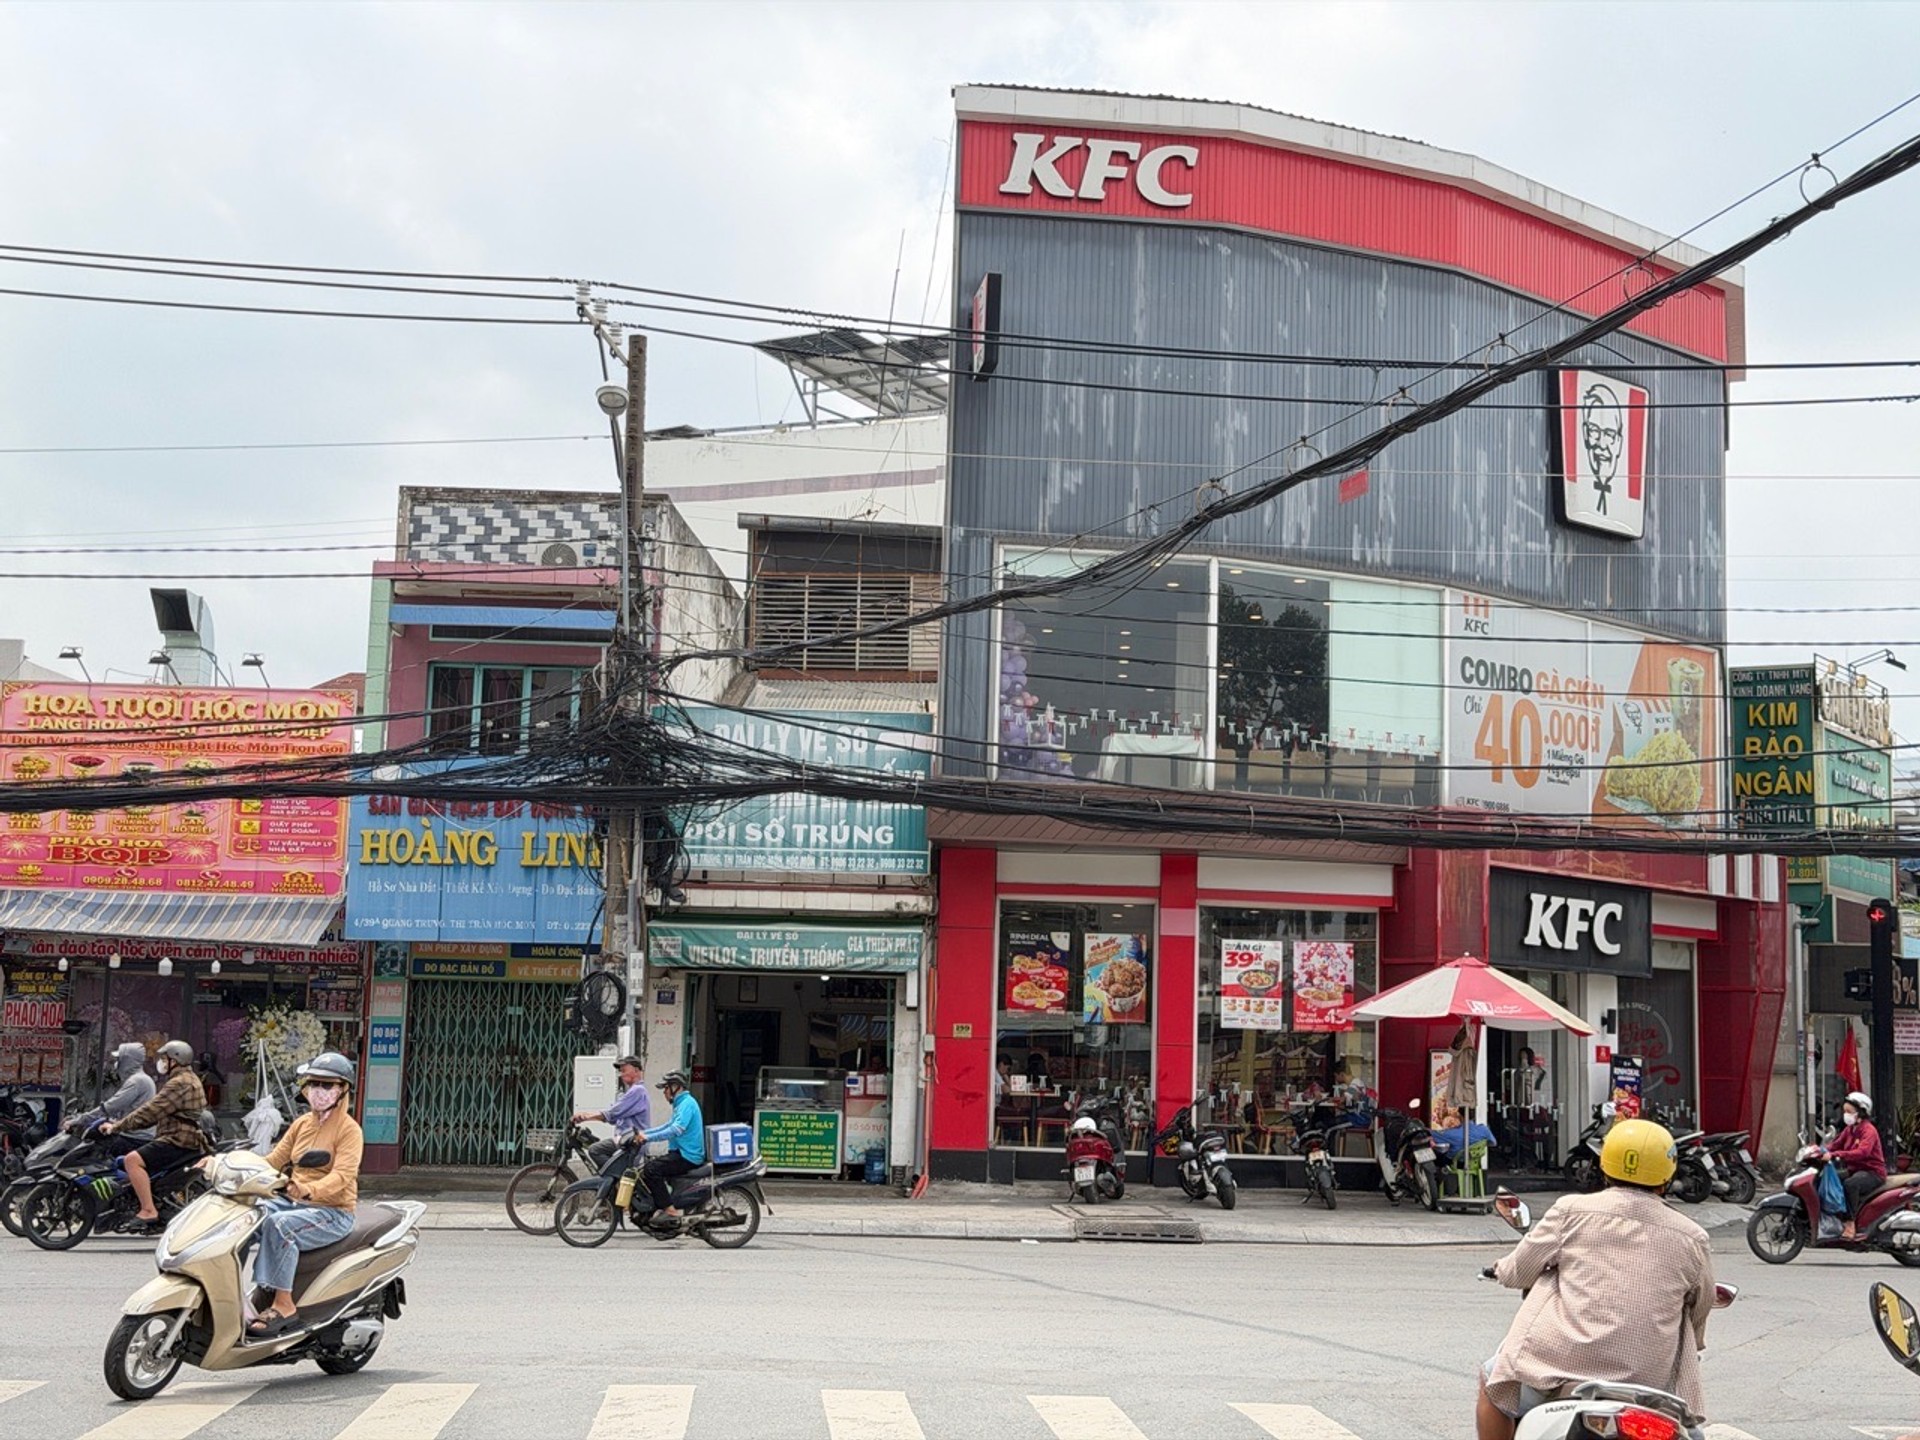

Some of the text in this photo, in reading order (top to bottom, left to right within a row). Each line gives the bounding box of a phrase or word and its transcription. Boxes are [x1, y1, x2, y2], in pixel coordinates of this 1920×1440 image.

[999, 133, 1199, 207] KFC
[1464, 618, 1489, 635] KFC
[1460, 655, 1533, 695] COMBO
[1536, 668, 1562, 701] GÀ
[1732, 669, 1809, 682] CÔNG TY TNHH MTV
[1732, 682, 1811, 697] KINH DOANH VÀNG
[263, 699, 341, 721] MÔN
[1748, 701, 1798, 727] KIM
[836, 719, 870, 753] SỐ
[1744, 730, 1805, 760] BẢO
[1734, 765, 1813, 797] NGÂN
[1466, 798, 1480, 807] KFC
[1776, 805, 1812, 823] ITALY
[50, 836, 166, 848] PHÁO HOA
[360, 817, 499, 866] HOÀNG
[745, 816, 786, 842] SỐ
[792, 818, 894, 845] TRÚNG
[47, 845, 172, 866] BQP
[1524, 893, 1622, 955] KFC
[847, 936, 864, 952] GIA
[895, 933, 919, 954] PHÁT
[1031, 933, 1049, 941] DEAL
[688, 944, 738, 965] VIETLOT
[750, 942, 799, 967] TRUYỀN
[803, 942, 845, 967] THỐNG
[4, 999, 66, 1028] PHÁO HOA
[810, 1121, 835, 1129] PHÁT
